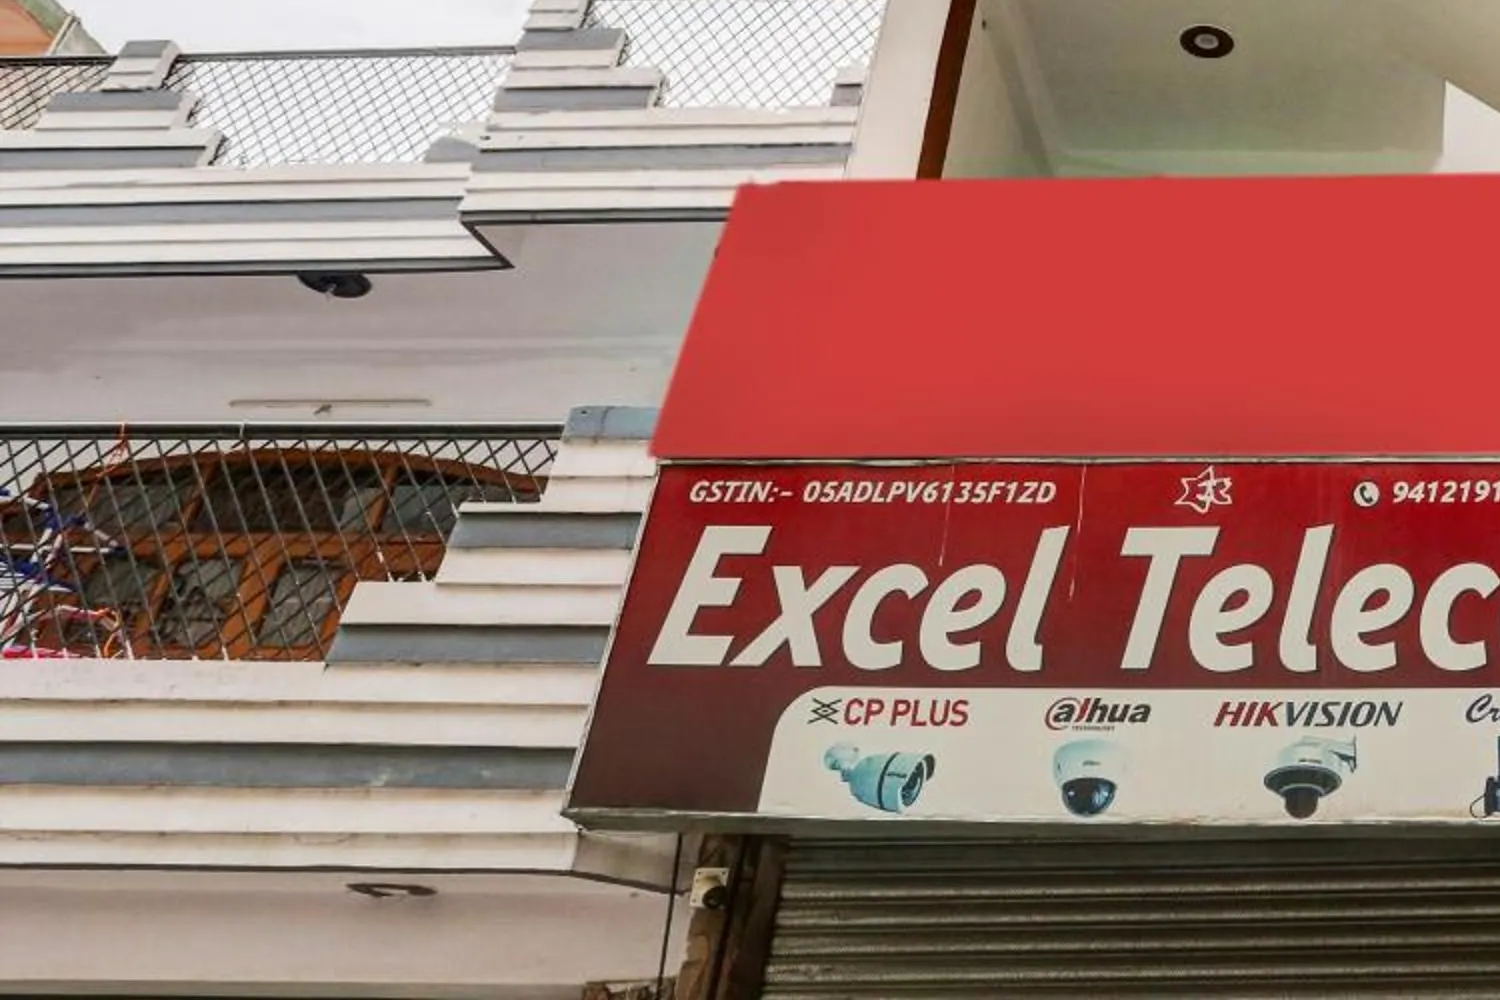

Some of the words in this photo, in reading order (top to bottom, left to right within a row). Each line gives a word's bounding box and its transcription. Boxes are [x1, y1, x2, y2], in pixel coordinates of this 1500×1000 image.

[646, 525, 1070, 671] Excel
[843, 697, 885, 726] CP
[889, 699, 970, 727] PLUS
[1213, 701, 1402, 728] HIKVISION
